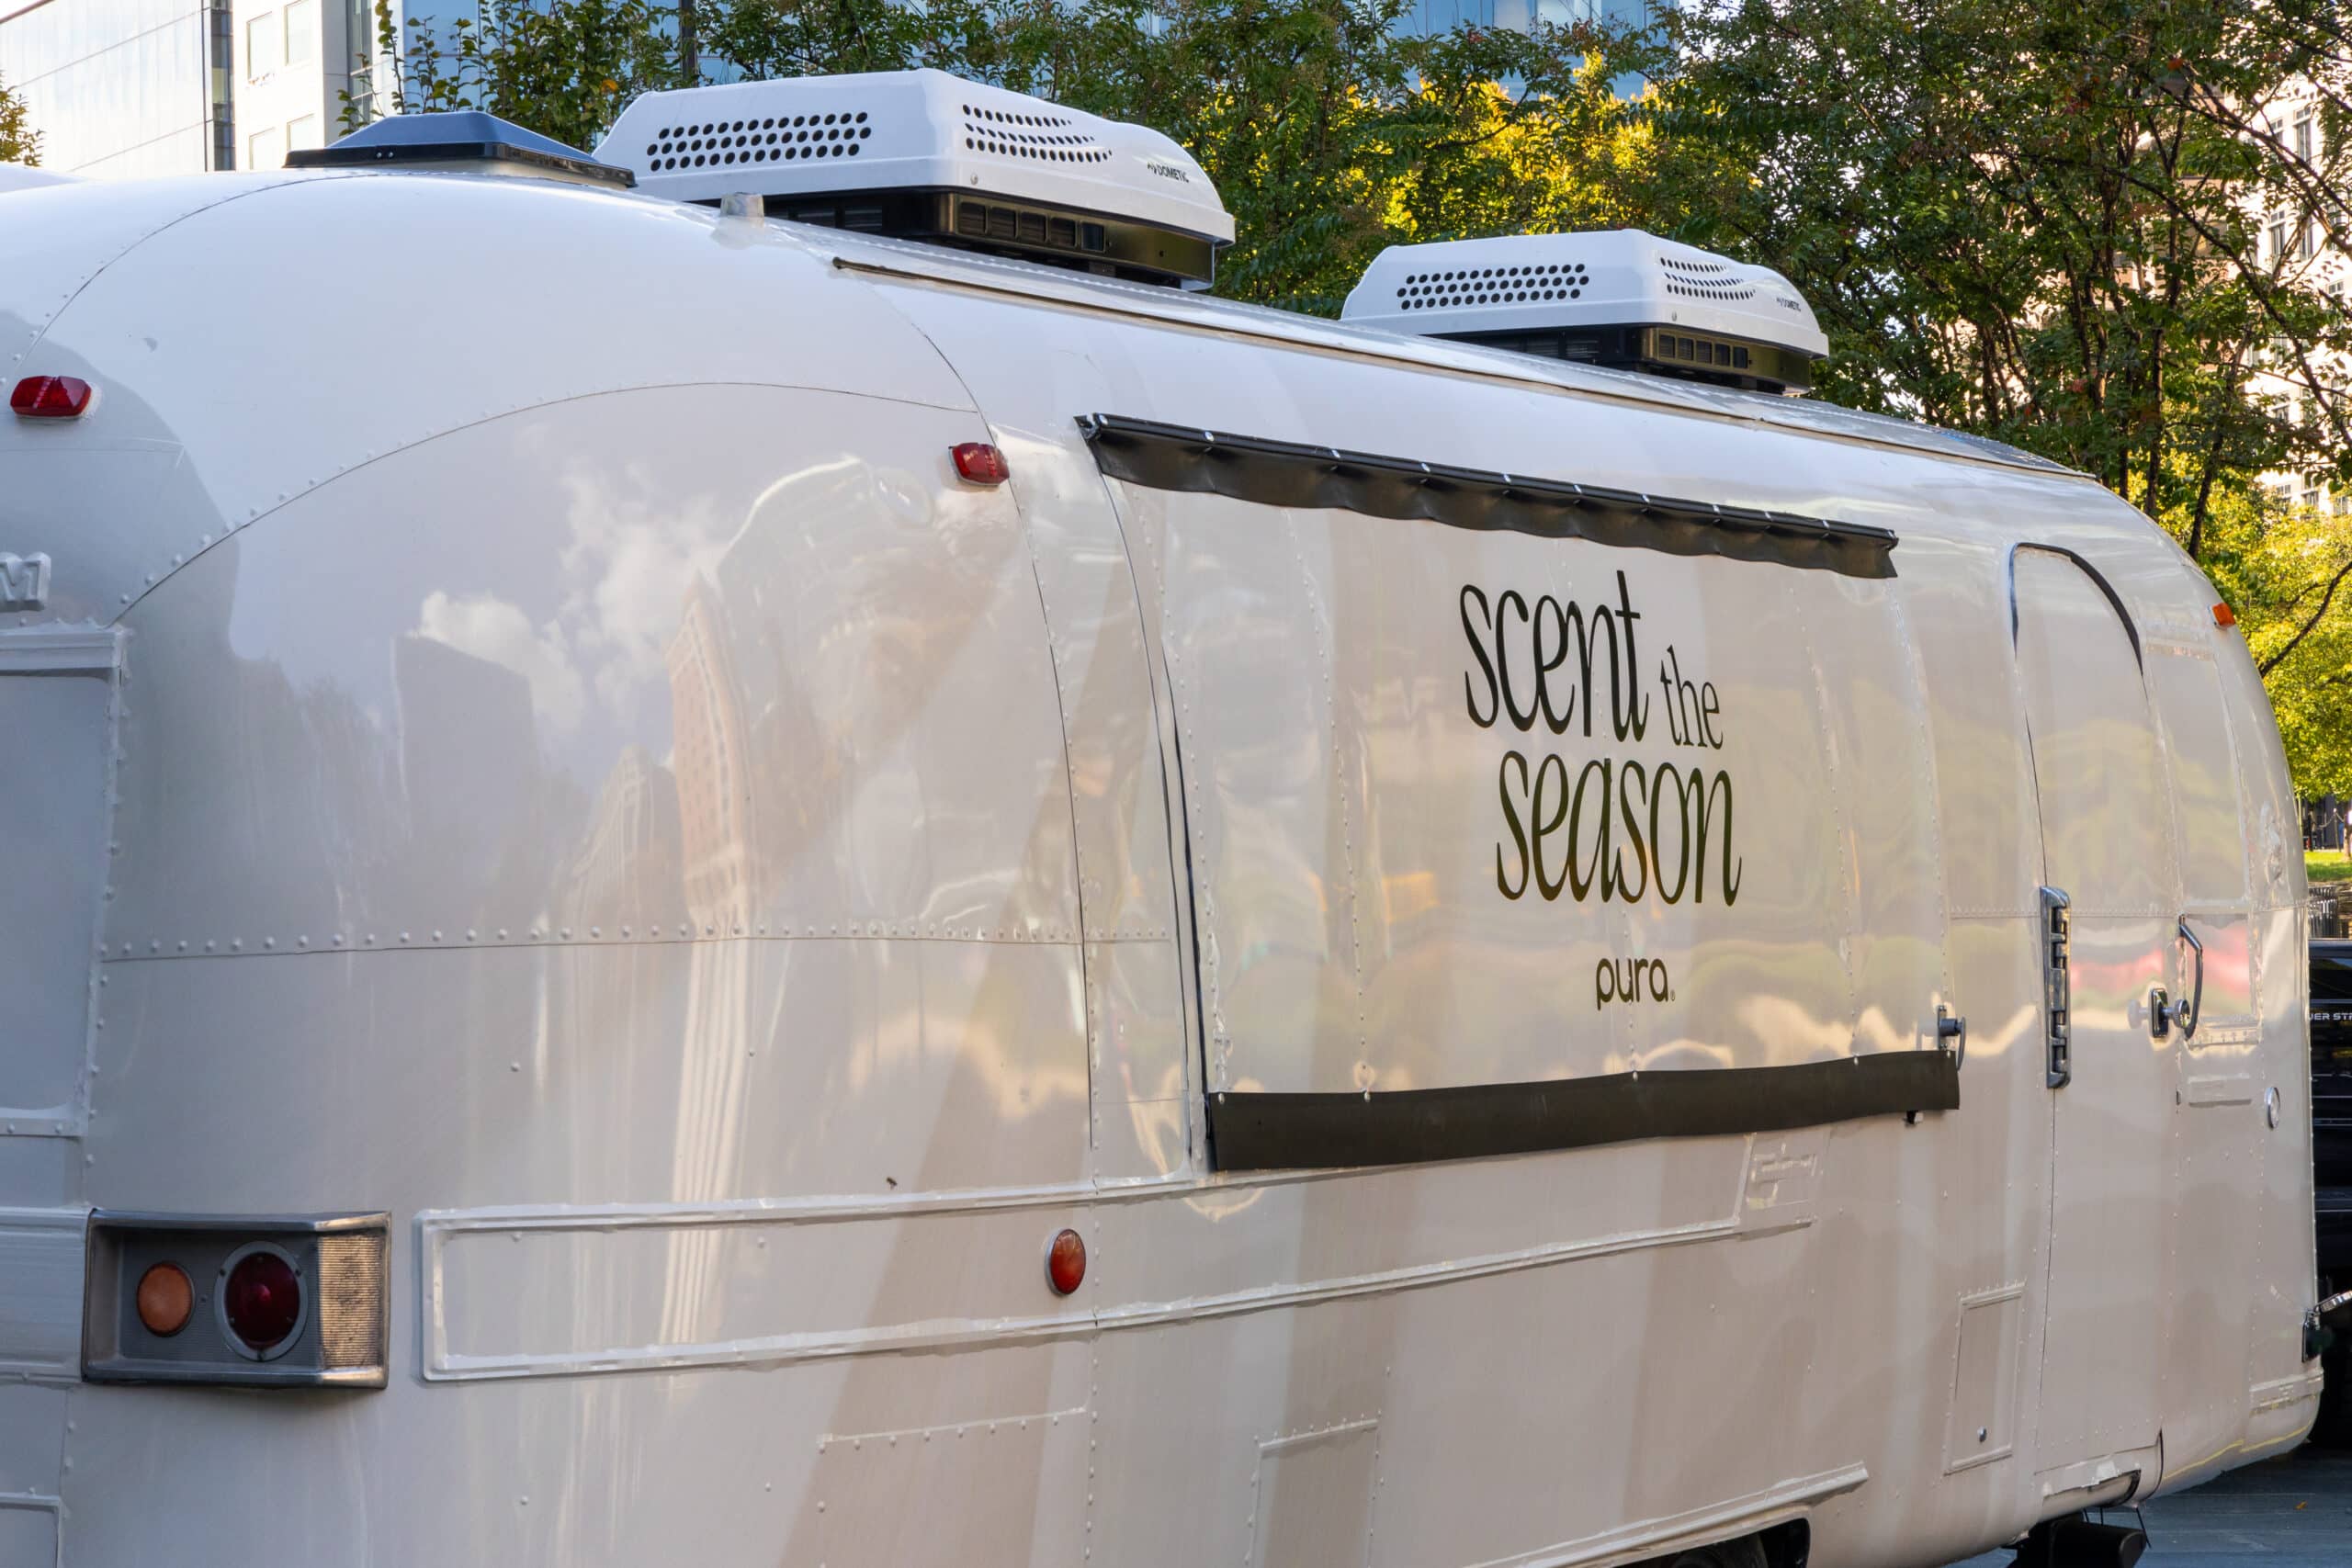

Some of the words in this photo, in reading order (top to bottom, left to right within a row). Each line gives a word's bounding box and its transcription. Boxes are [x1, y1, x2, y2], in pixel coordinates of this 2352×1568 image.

[1459, 570, 1650, 743] scent
[1659, 645, 1724, 750] the
[1496, 750, 1743, 908] season
